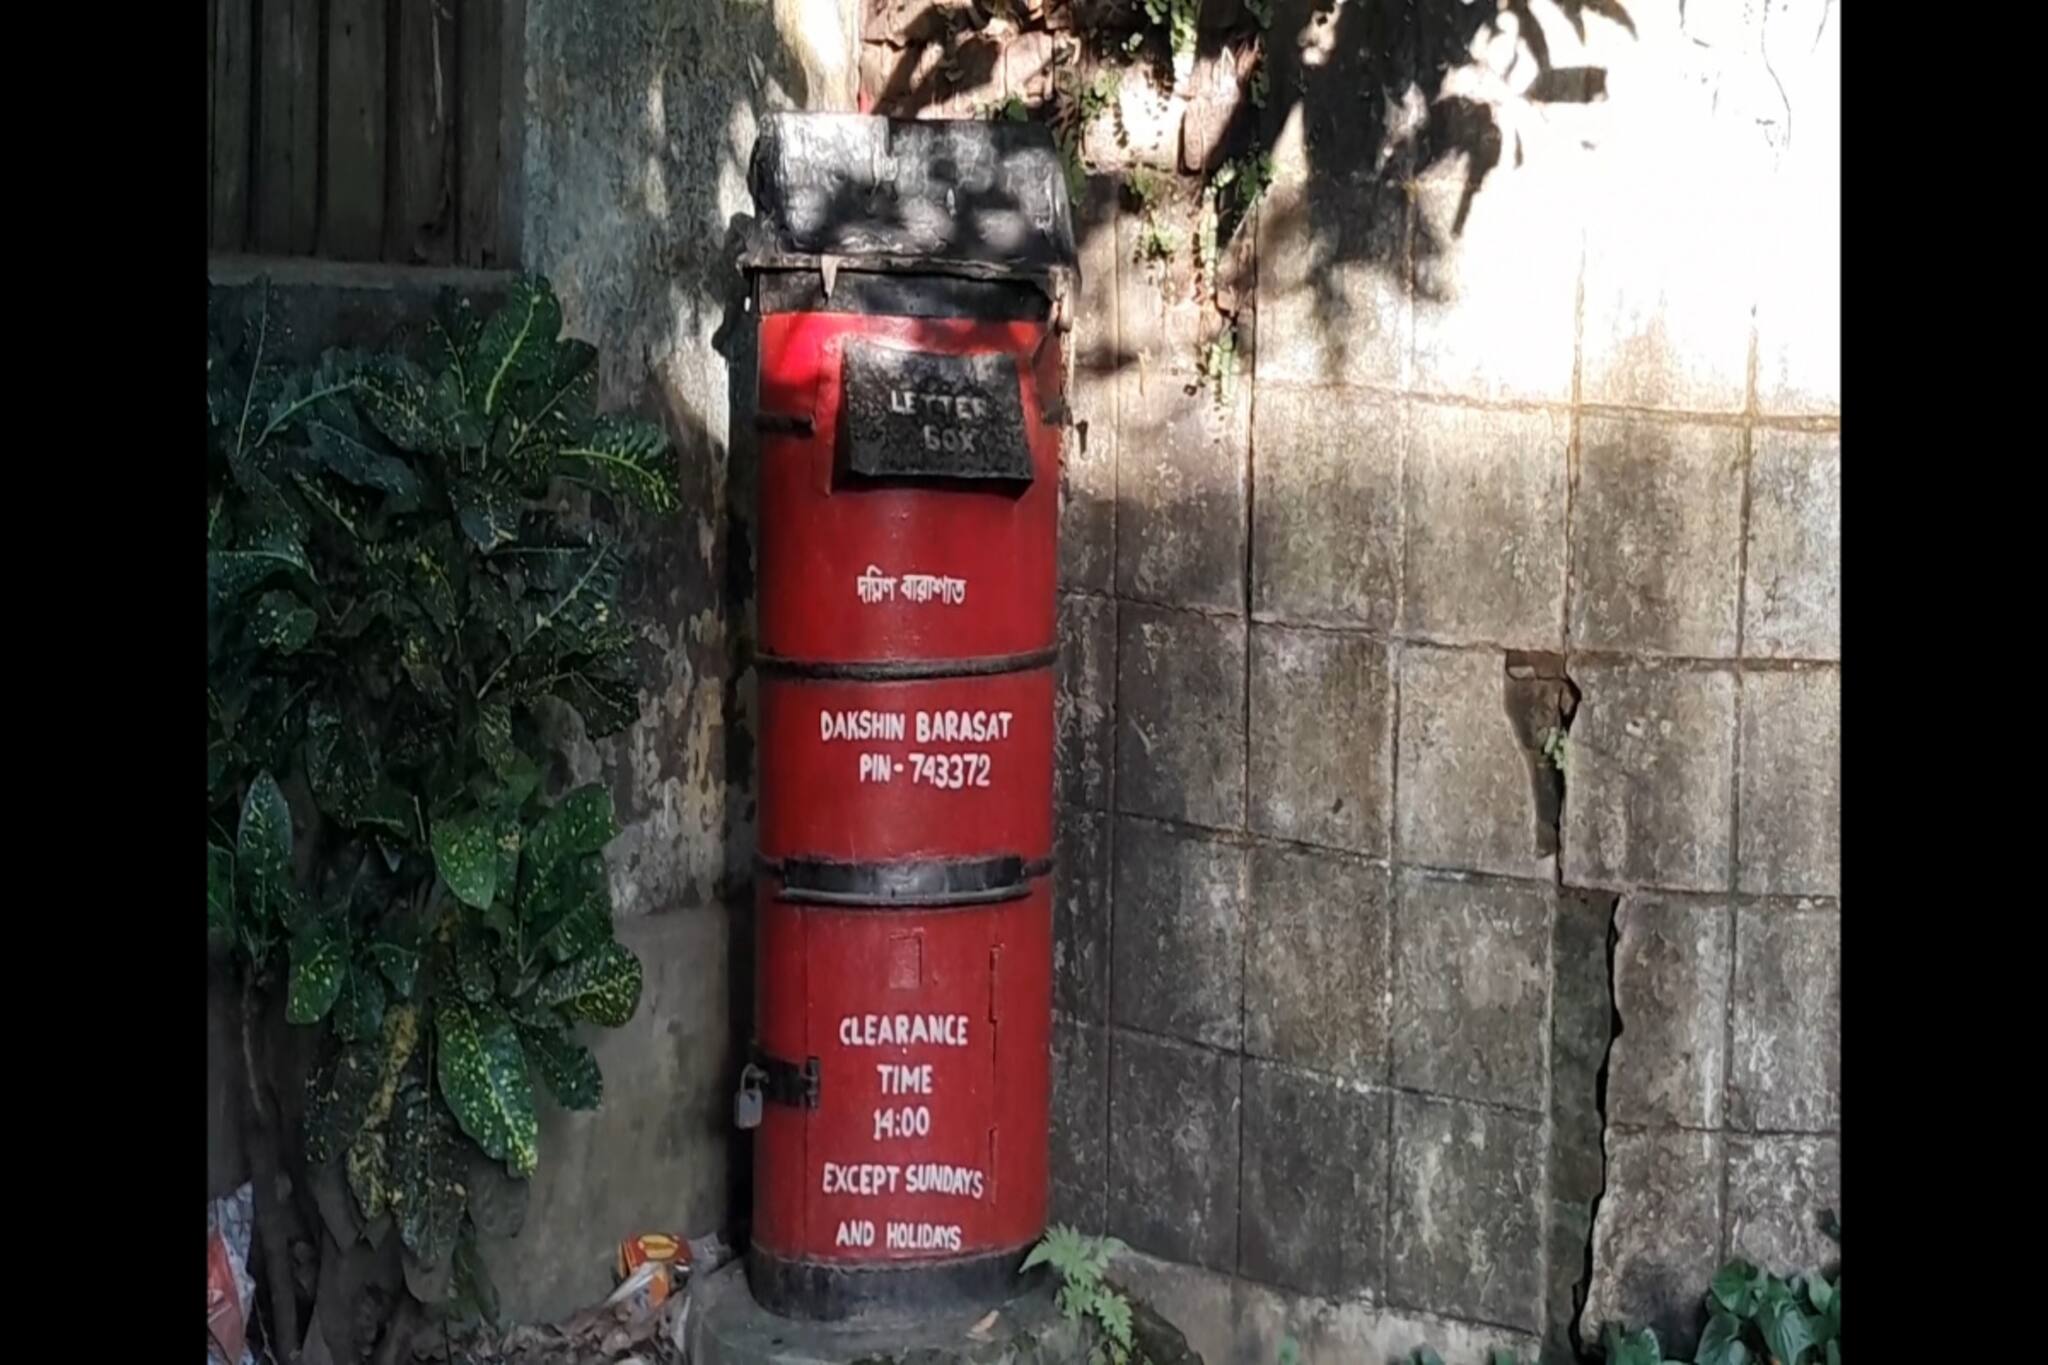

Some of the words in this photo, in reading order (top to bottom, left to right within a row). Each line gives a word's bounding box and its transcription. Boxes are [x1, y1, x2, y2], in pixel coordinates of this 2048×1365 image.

[890, 388, 987, 420] LETTER
[820, 710, 905, 741] DAKSHIN
[916, 710, 1013, 743] BARASAT
[839, 1014, 969, 1046] CLEARANCE
[877, 1064, 933, 1095] TIME
[873, 1106, 930, 1141] 14:00
[822, 1162, 900, 1196] EXCEPT
[905, 1163, 984, 1200] SUNDAYS
[836, 1219, 875, 1247] AND
[886, 1221, 962, 1252] HOLIDAYS
